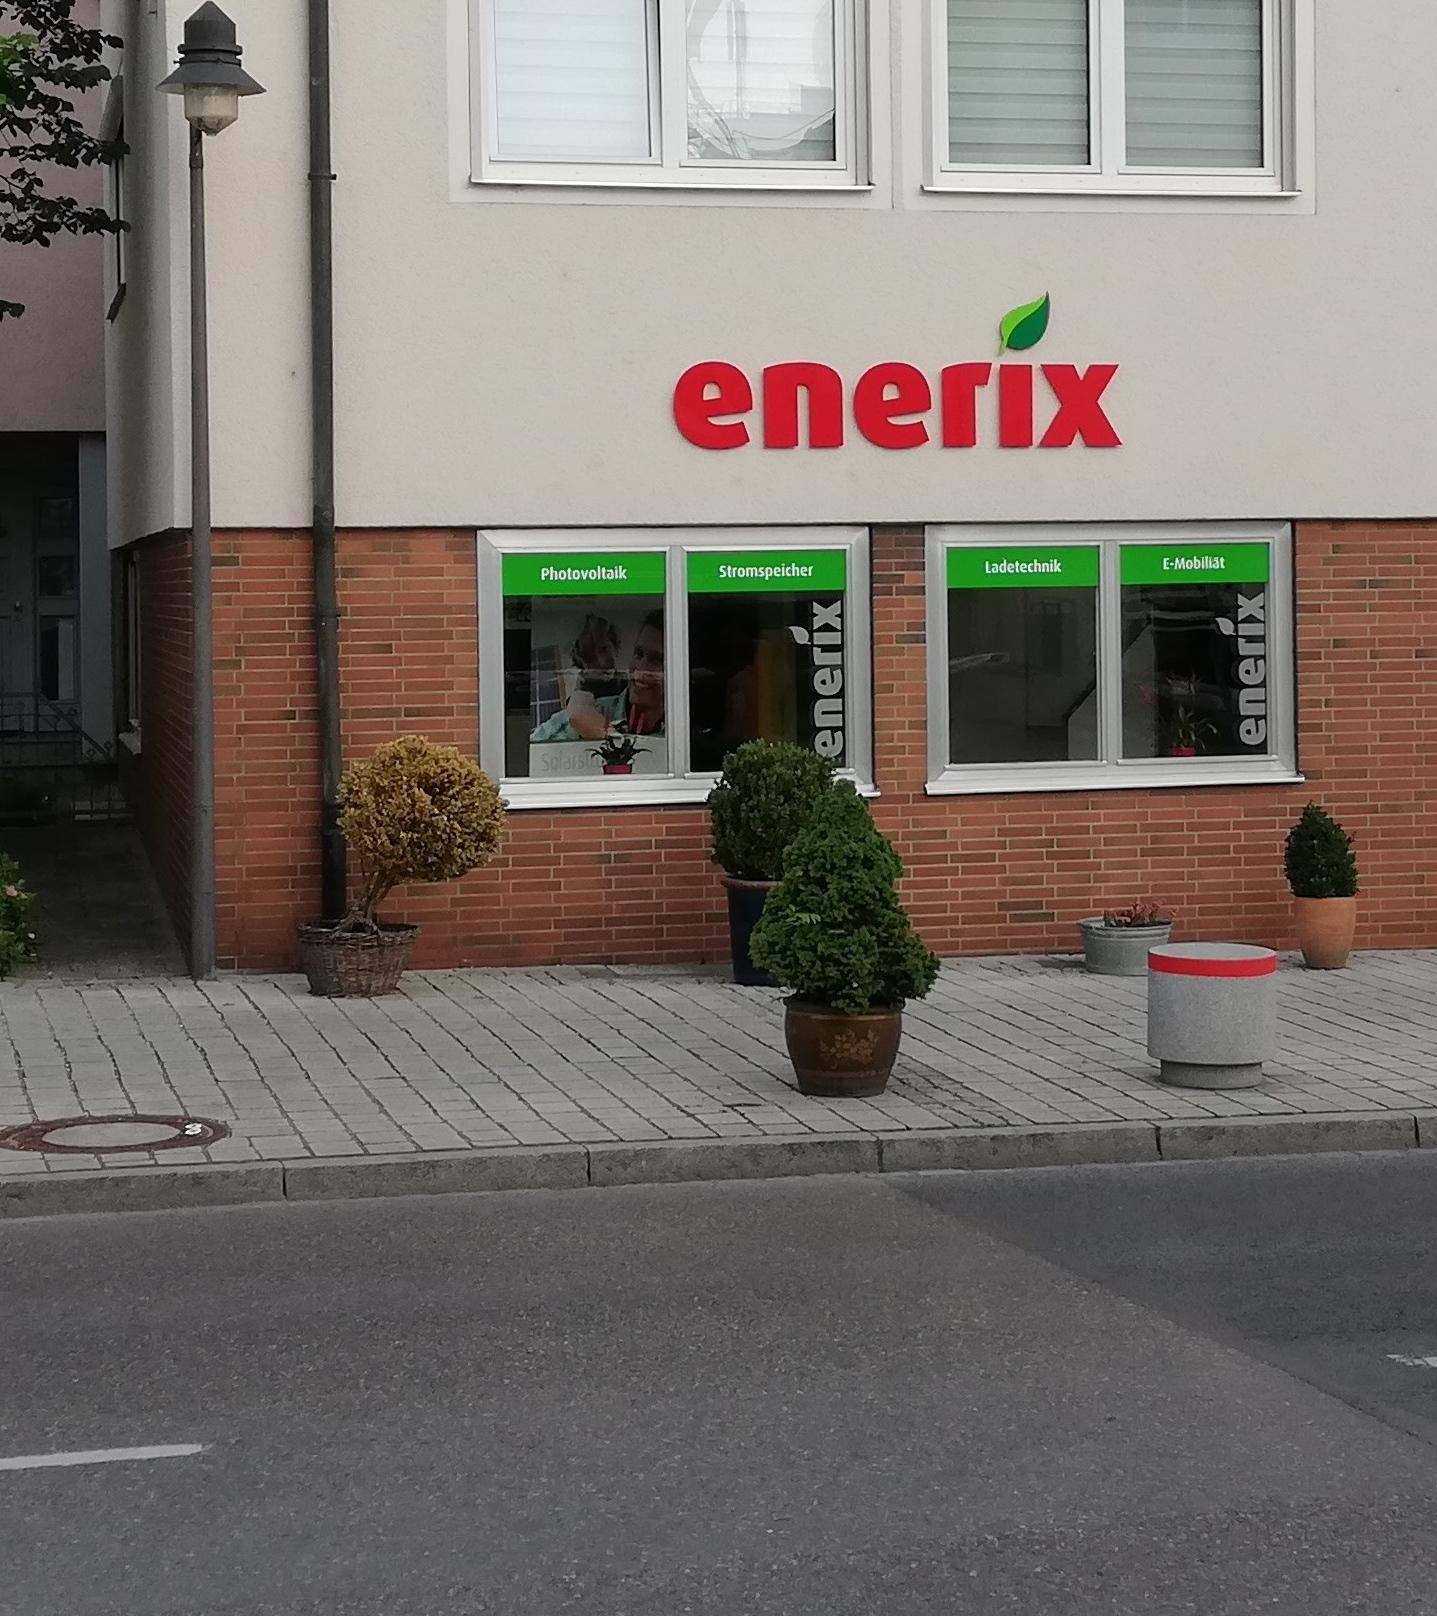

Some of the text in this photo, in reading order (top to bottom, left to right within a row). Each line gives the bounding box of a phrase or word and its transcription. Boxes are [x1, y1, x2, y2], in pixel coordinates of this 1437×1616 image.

[673, 361, 1123, 450] enerix
[540, 565, 627, 581] Photovoltaik
[718, 562, 814, 580] Stromspeicher
[985, 558, 1062, 574] Ladetechnik
[812, 600, 844, 758] enerix
[1236, 592, 1267, 746] enerix
